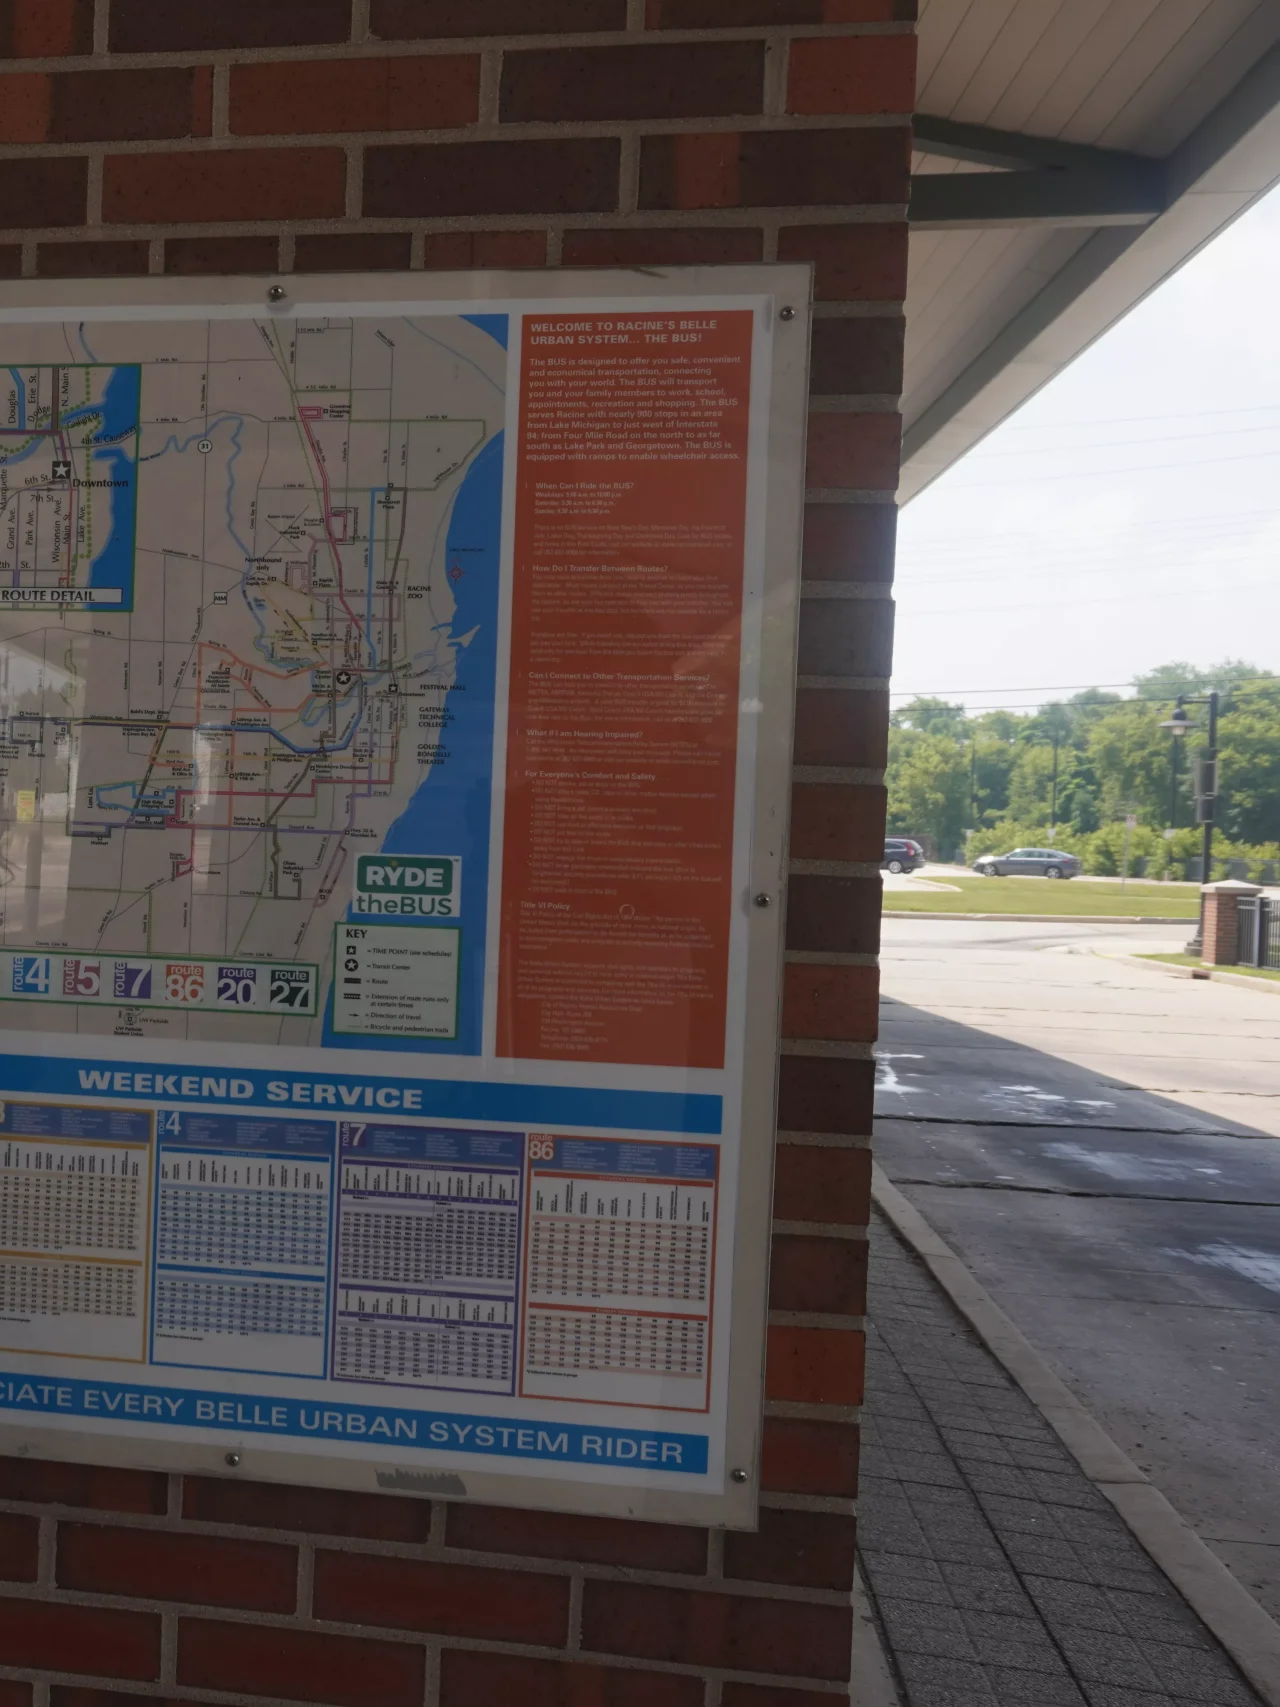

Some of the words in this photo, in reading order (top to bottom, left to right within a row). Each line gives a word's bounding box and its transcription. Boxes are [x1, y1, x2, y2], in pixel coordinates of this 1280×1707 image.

[531, 323, 592, 332] WELCOME
[597, 322, 612, 330] TO
[617, 321, 675, 330] RACINE'S
[680, 320, 717, 329] BELLE
[531, 335, 573, 344] URBAN
[578, 335, 639, 344] SYSTEM...
[645, 334, 667, 343] THE
[672, 334, 702, 343] BUS!
[578, 358, 616, 366] designed
[693, 356, 740, 364] convenient
[28, 389, 36, 403] Erie
[8, 390, 18, 423] Douglas
[28, 406, 51, 422] Dodge
[67, 414, 91, 428] Gaslight
[104, 425, 137, 442] Causeway
[0, 469, 9, 511] Marquette
[73, 479, 128, 487] Downtown
[54, 498, 62, 515] Ave.
[7, 528, 15, 549] Grand
[52, 521, 60, 563] Wisconsin
[2, 591, 46, 600] ROUTE
[51, 591, 94, 601] DETAIL
[366, 866, 444, 887] RYDE
[357, 894, 452, 915] theBUS
[548, 903, 570, 911] Policy
[346, 929, 367, 938] KEY
[13, 957, 24, 990] route
[25, 957, 50, 992] 4
[64, 960, 75, 993] route
[77, 960, 99, 994] 5
[115, 963, 126, 996] route
[127, 966, 152, 996] 7
[170, 966, 202, 975] route
[223, 968, 254, 978] route
[275, 971, 306, 980] route
[165, 976, 204, 1003] 86
[218, 979, 256, 1004] 20
[270, 982, 309, 1009] 27
[78, 1070, 254, 1098] WEEKEND
[266, 1080, 423, 1110] SERVICE
[166, 1112, 181, 1136] 4
[350, 1124, 366, 1146] 7
[529, 1142, 554, 1160] 86
[84, 1390, 184, 1416] EVERY
[196, 1399, 287, 1427] BELLE
[300, 1409, 418, 1438] URBAN
[429, 1422, 568, 1453] SYSTEM
[582, 1435, 683, 1463] RIDER
